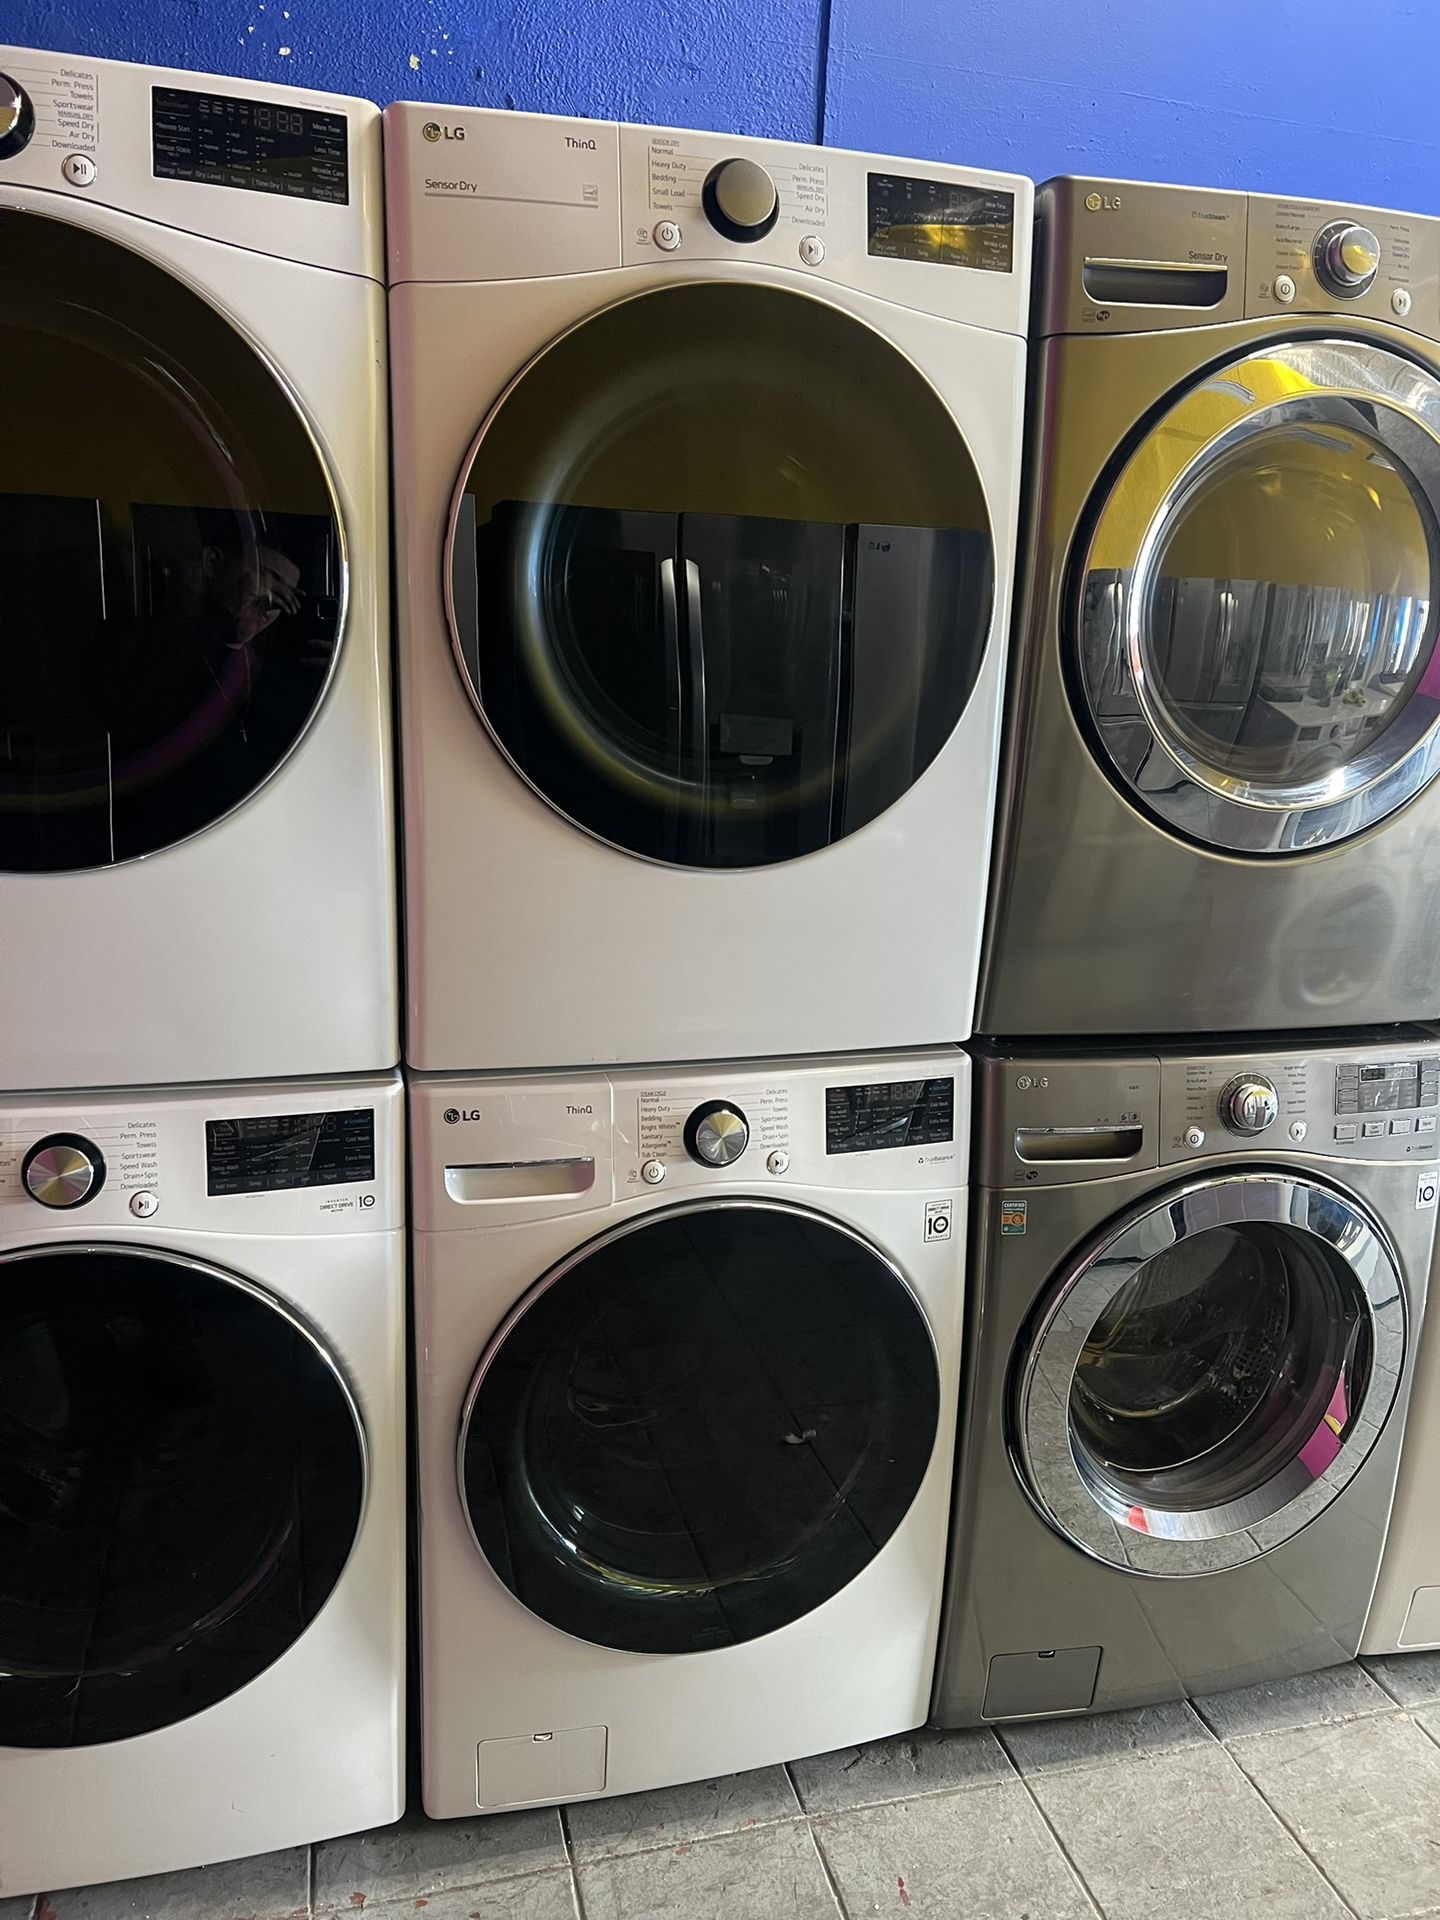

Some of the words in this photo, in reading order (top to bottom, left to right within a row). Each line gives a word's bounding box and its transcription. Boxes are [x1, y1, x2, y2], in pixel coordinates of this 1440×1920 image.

[60, 69, 94, 80] Delicates
[51, 79, 71, 88] Perm.
[73, 81, 94, 91] Press
[70, 91, 94, 101] Towels
[53, 99, 94, 111] Sportswear
[57, 119, 80, 128] Speed
[81, 121, 95, 131] Dry
[82, 132, 95, 142] Dry
[444, 127, 465, 141] LG
[52, 140, 96, 152] Downloaded
[565, 137, 597, 150] ThinQ
[651, 147, 674, 156] Normal
[157, 165, 176, 175] Energy
[652, 160, 671, 170] Heavy
[672, 162, 686, 171] Duty
[799, 163, 824, 173] Delicates
[195, 170, 206, 179] Dry
[207, 171, 222, 180] Level
[652, 173, 677, 184] Bedding
[792, 175, 807, 183] Perm.
[809, 177, 825, 186] Press
[269, 180, 280, 190] Dry
[425, 179, 459, 191] Sensor
[459, 180, 477, 193] Dry
[652, 187, 669, 196] Small
[670, 189, 685, 198] Load
[796, 192, 812, 202] Speed
[814, 194, 825, 203] Dry
[653, 202, 673, 211] Towels
[1103, 196, 1121, 210] LG
[814, 206, 825, 216] Dry
[792, 216, 826, 227] Downloaded
[1188, 251, 1214, 261] Sensor
[1215, 252, 1228, 262] Dry
[1033, 1077, 1049, 1088] LG
[566, 1105, 593, 1114] ThinQ
[462, 1110, 480, 1121] LG
[136, 1141, 157, 1149] Towels
[760, 1141, 789, 1149] Downloaded
[121, 1152, 157, 1160] Sportswear
[120, 1162, 139, 1171] Speed
[120, 1181, 158, 1190] Downloaded
[1419, 1186, 1435, 1203] 10
[359, 1195, 375, 1208] 10
[928, 1216, 949, 1235] 10
